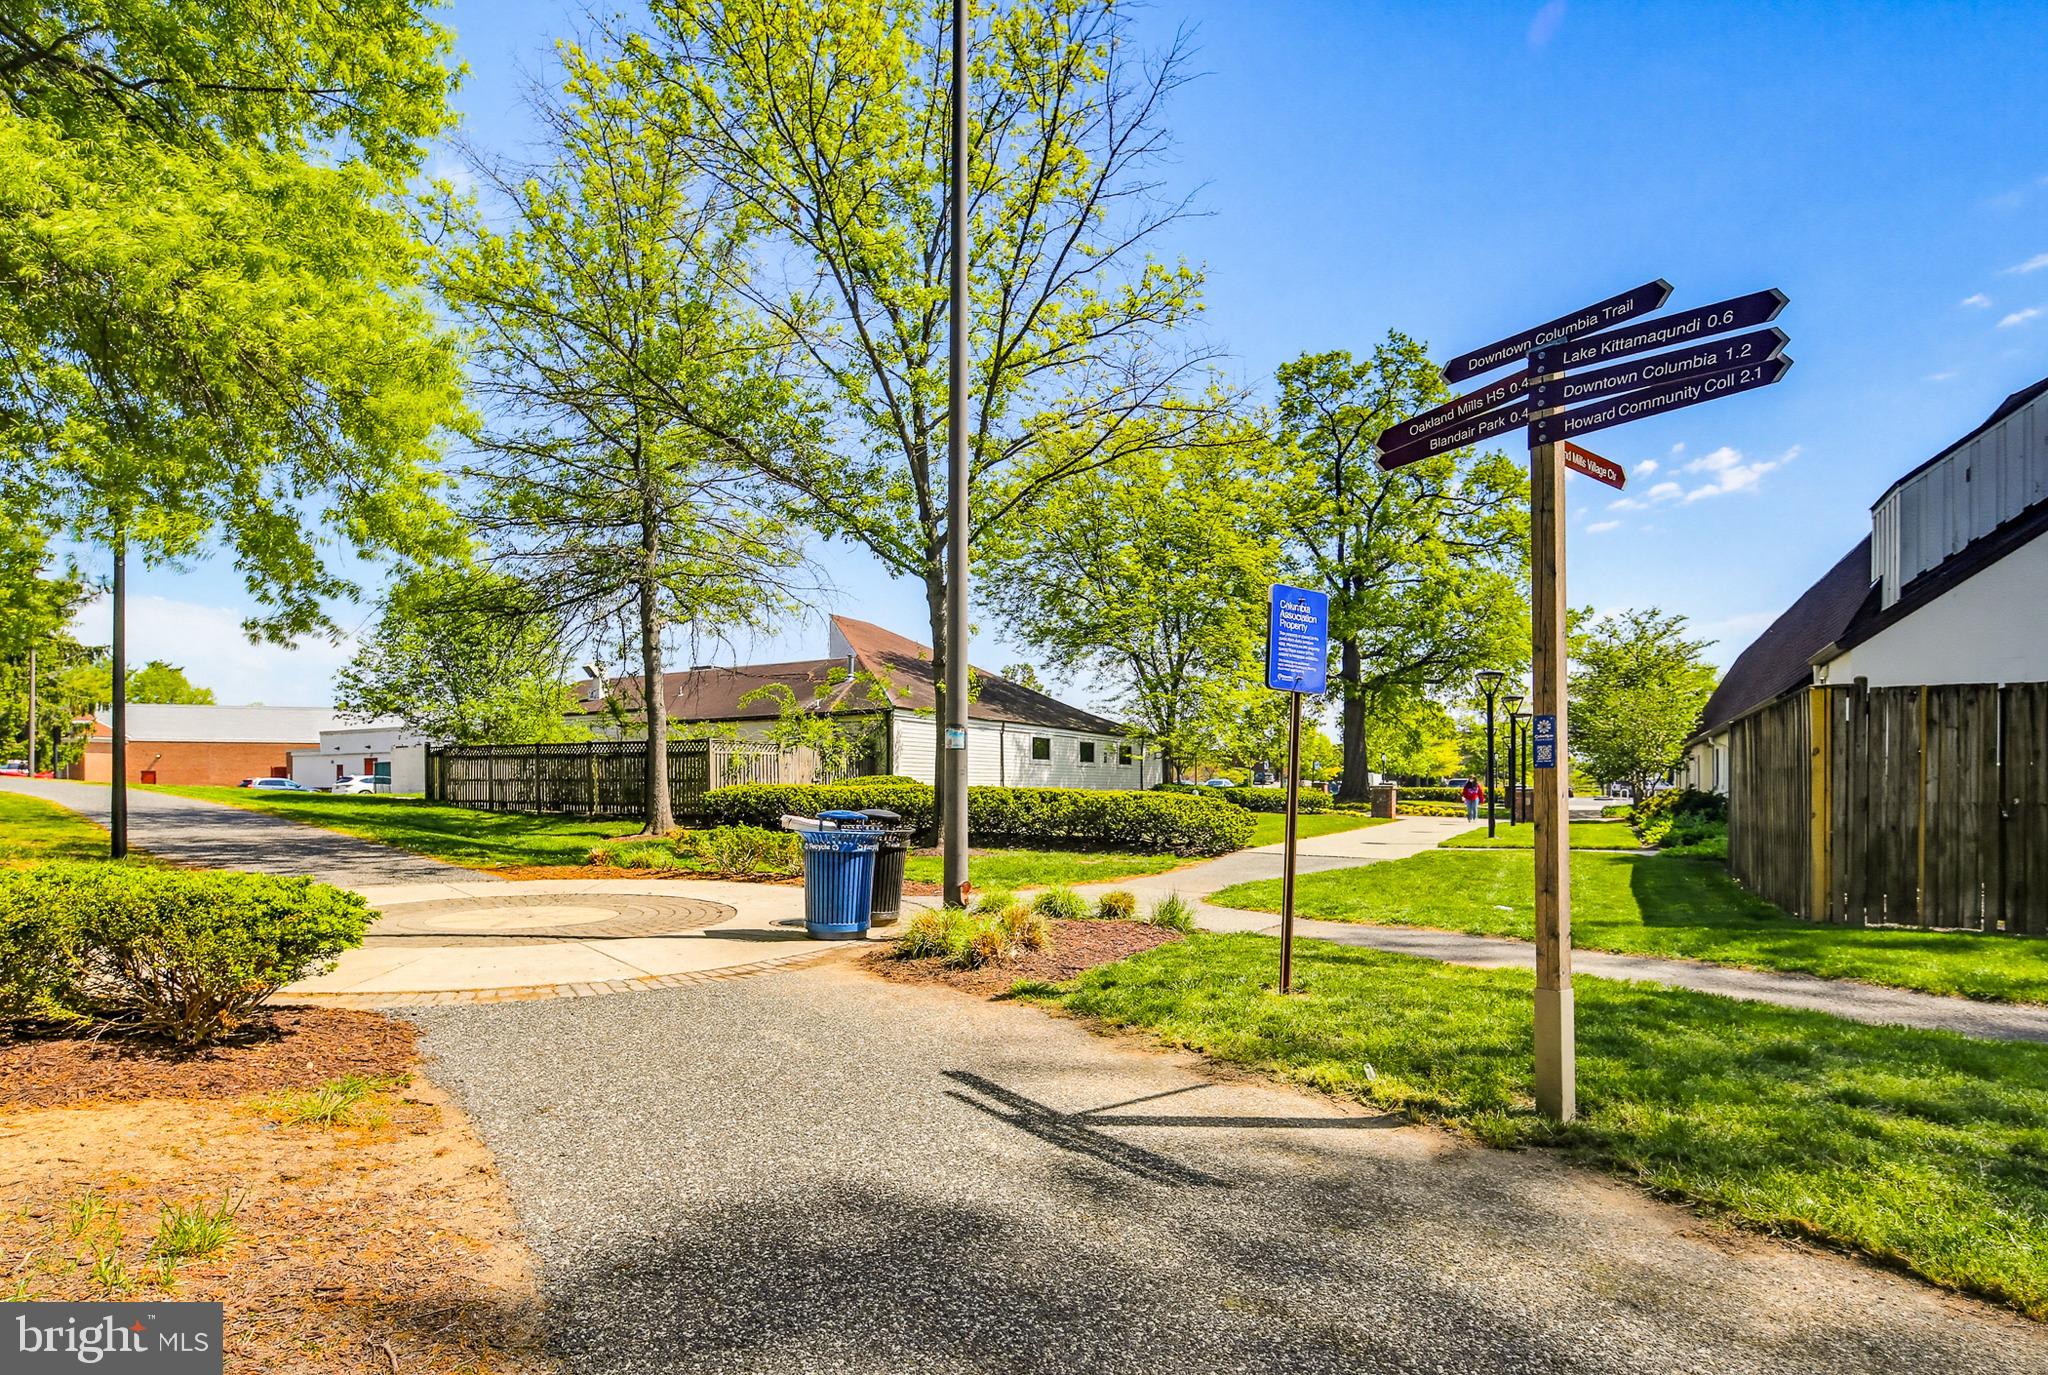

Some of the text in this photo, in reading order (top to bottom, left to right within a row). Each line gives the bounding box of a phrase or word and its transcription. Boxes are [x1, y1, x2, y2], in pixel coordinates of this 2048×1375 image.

[1469, 299, 1634, 371] Downtown Columbia Trail
[1563, 310, 1734, 364] Lake Kittamaqundi 0.6
[1563, 343, 1752, 398] Downtown Columbia 1.2
[1409, 377, 1529, 436] Oakland Mills HS 0.4
[1564, 367, 1762, 432] Howard Community Coll 2.1
[1429, 407, 1529, 450] Blandair Park 0.4
[1572, 452, 1587, 468] Mills
[1587, 459, 1607, 479] Village
[1280, 599, 1311, 614] Columbia
[1280, 609, 1318, 624] Association
[1280, 618, 1308, 634] Property
